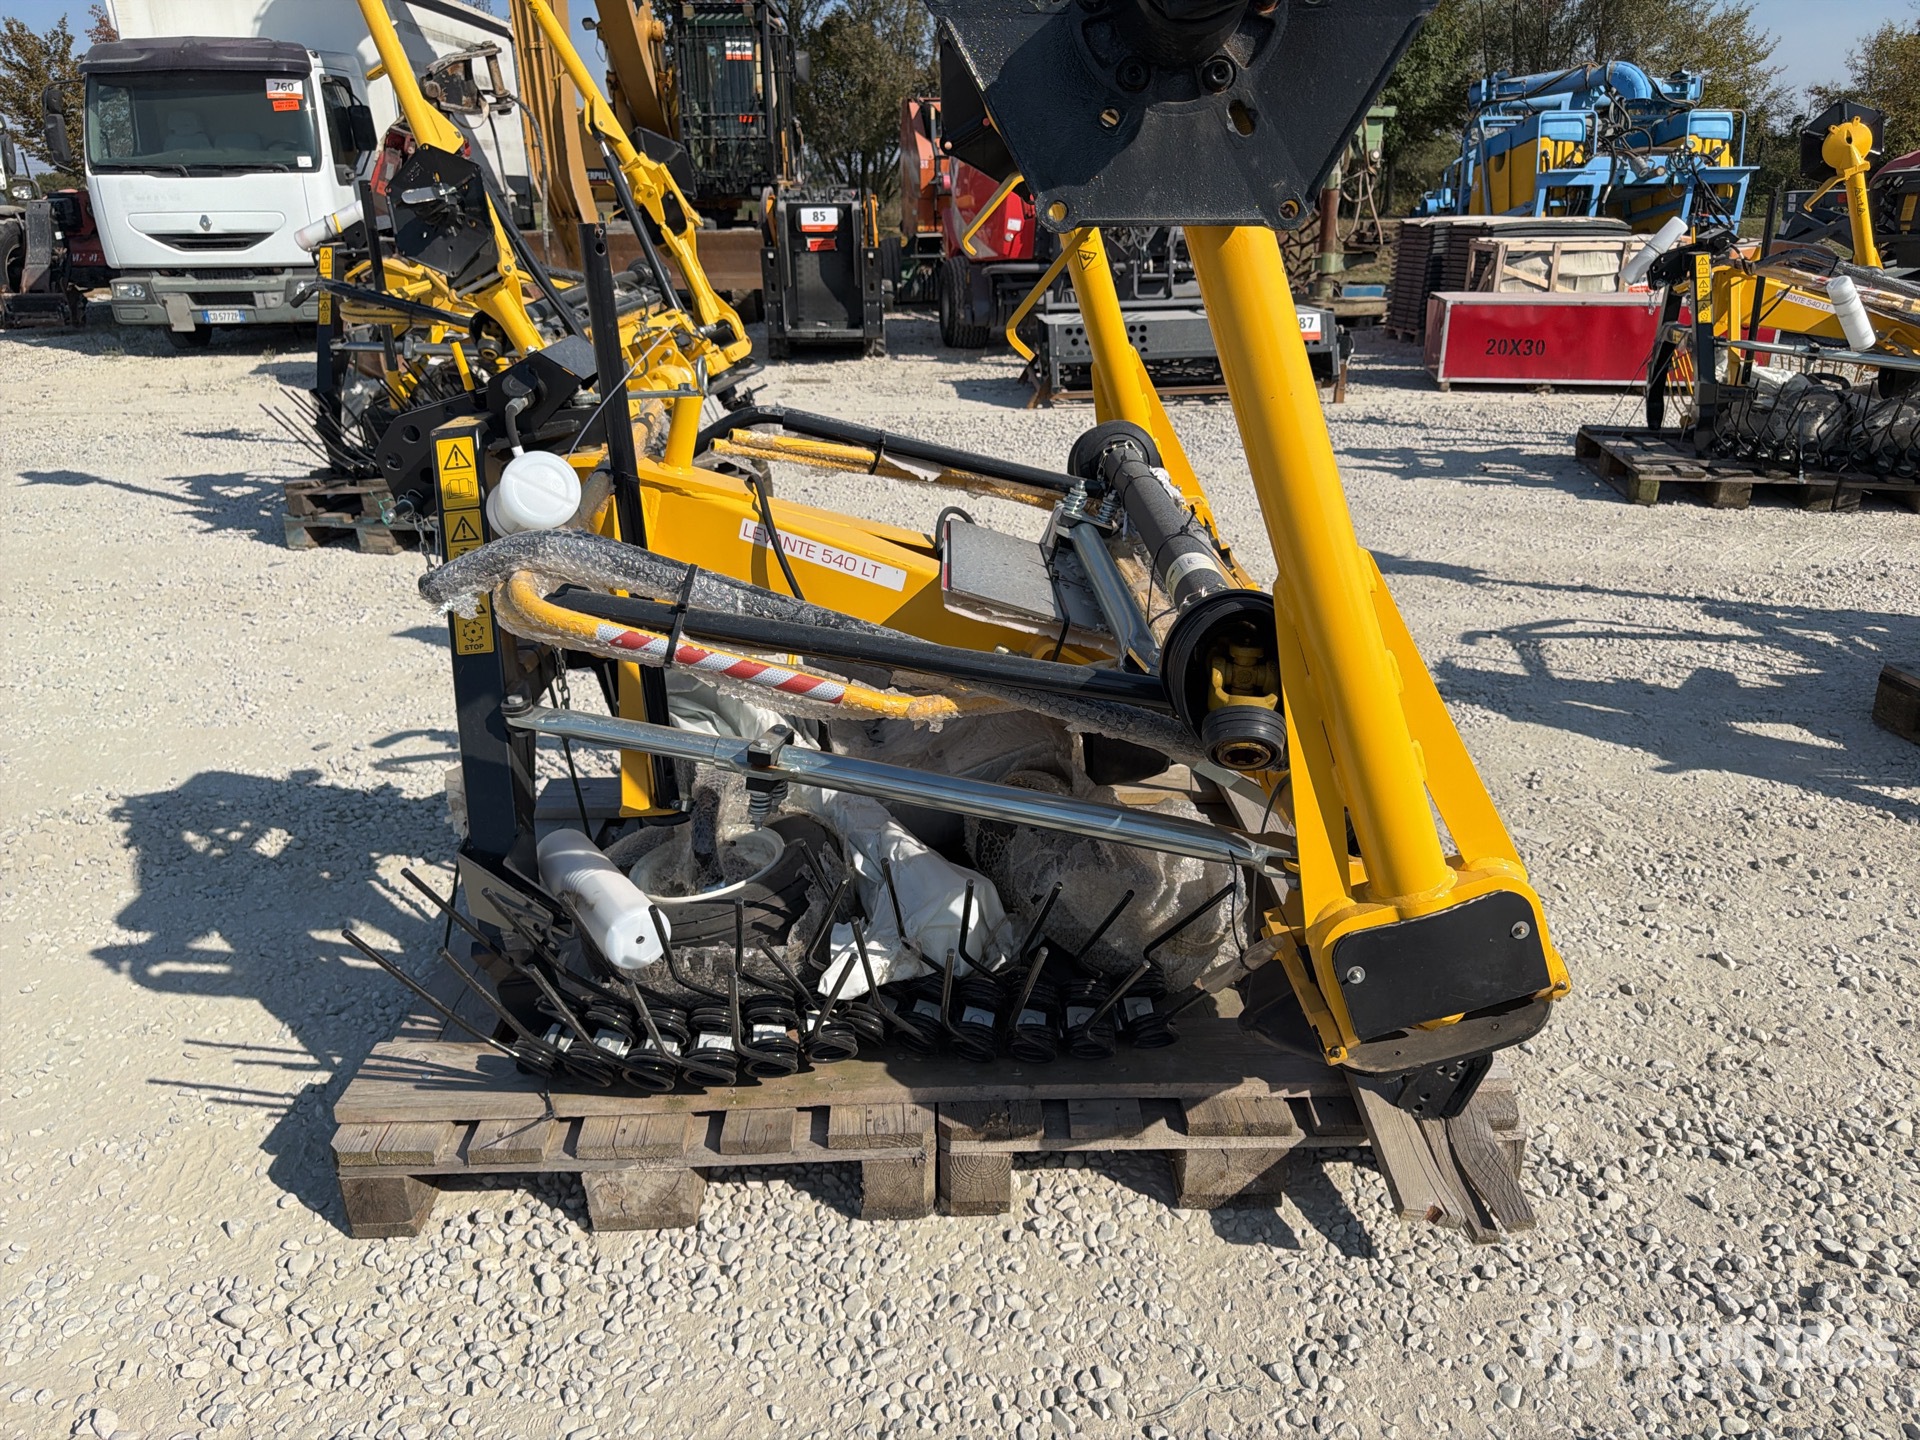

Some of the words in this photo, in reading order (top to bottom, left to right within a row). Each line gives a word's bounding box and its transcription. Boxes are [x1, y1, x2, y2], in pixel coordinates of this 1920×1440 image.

[274, 82, 294, 91] 760
[812, 211, 826, 222] 85
[1806, 299, 1821, 308] 540
[1485, 338, 1546, 356] 20X30
[821, 549, 857, 572] 540
[861, 561, 881, 579] LT
[464, 643, 485, 651] STOP
